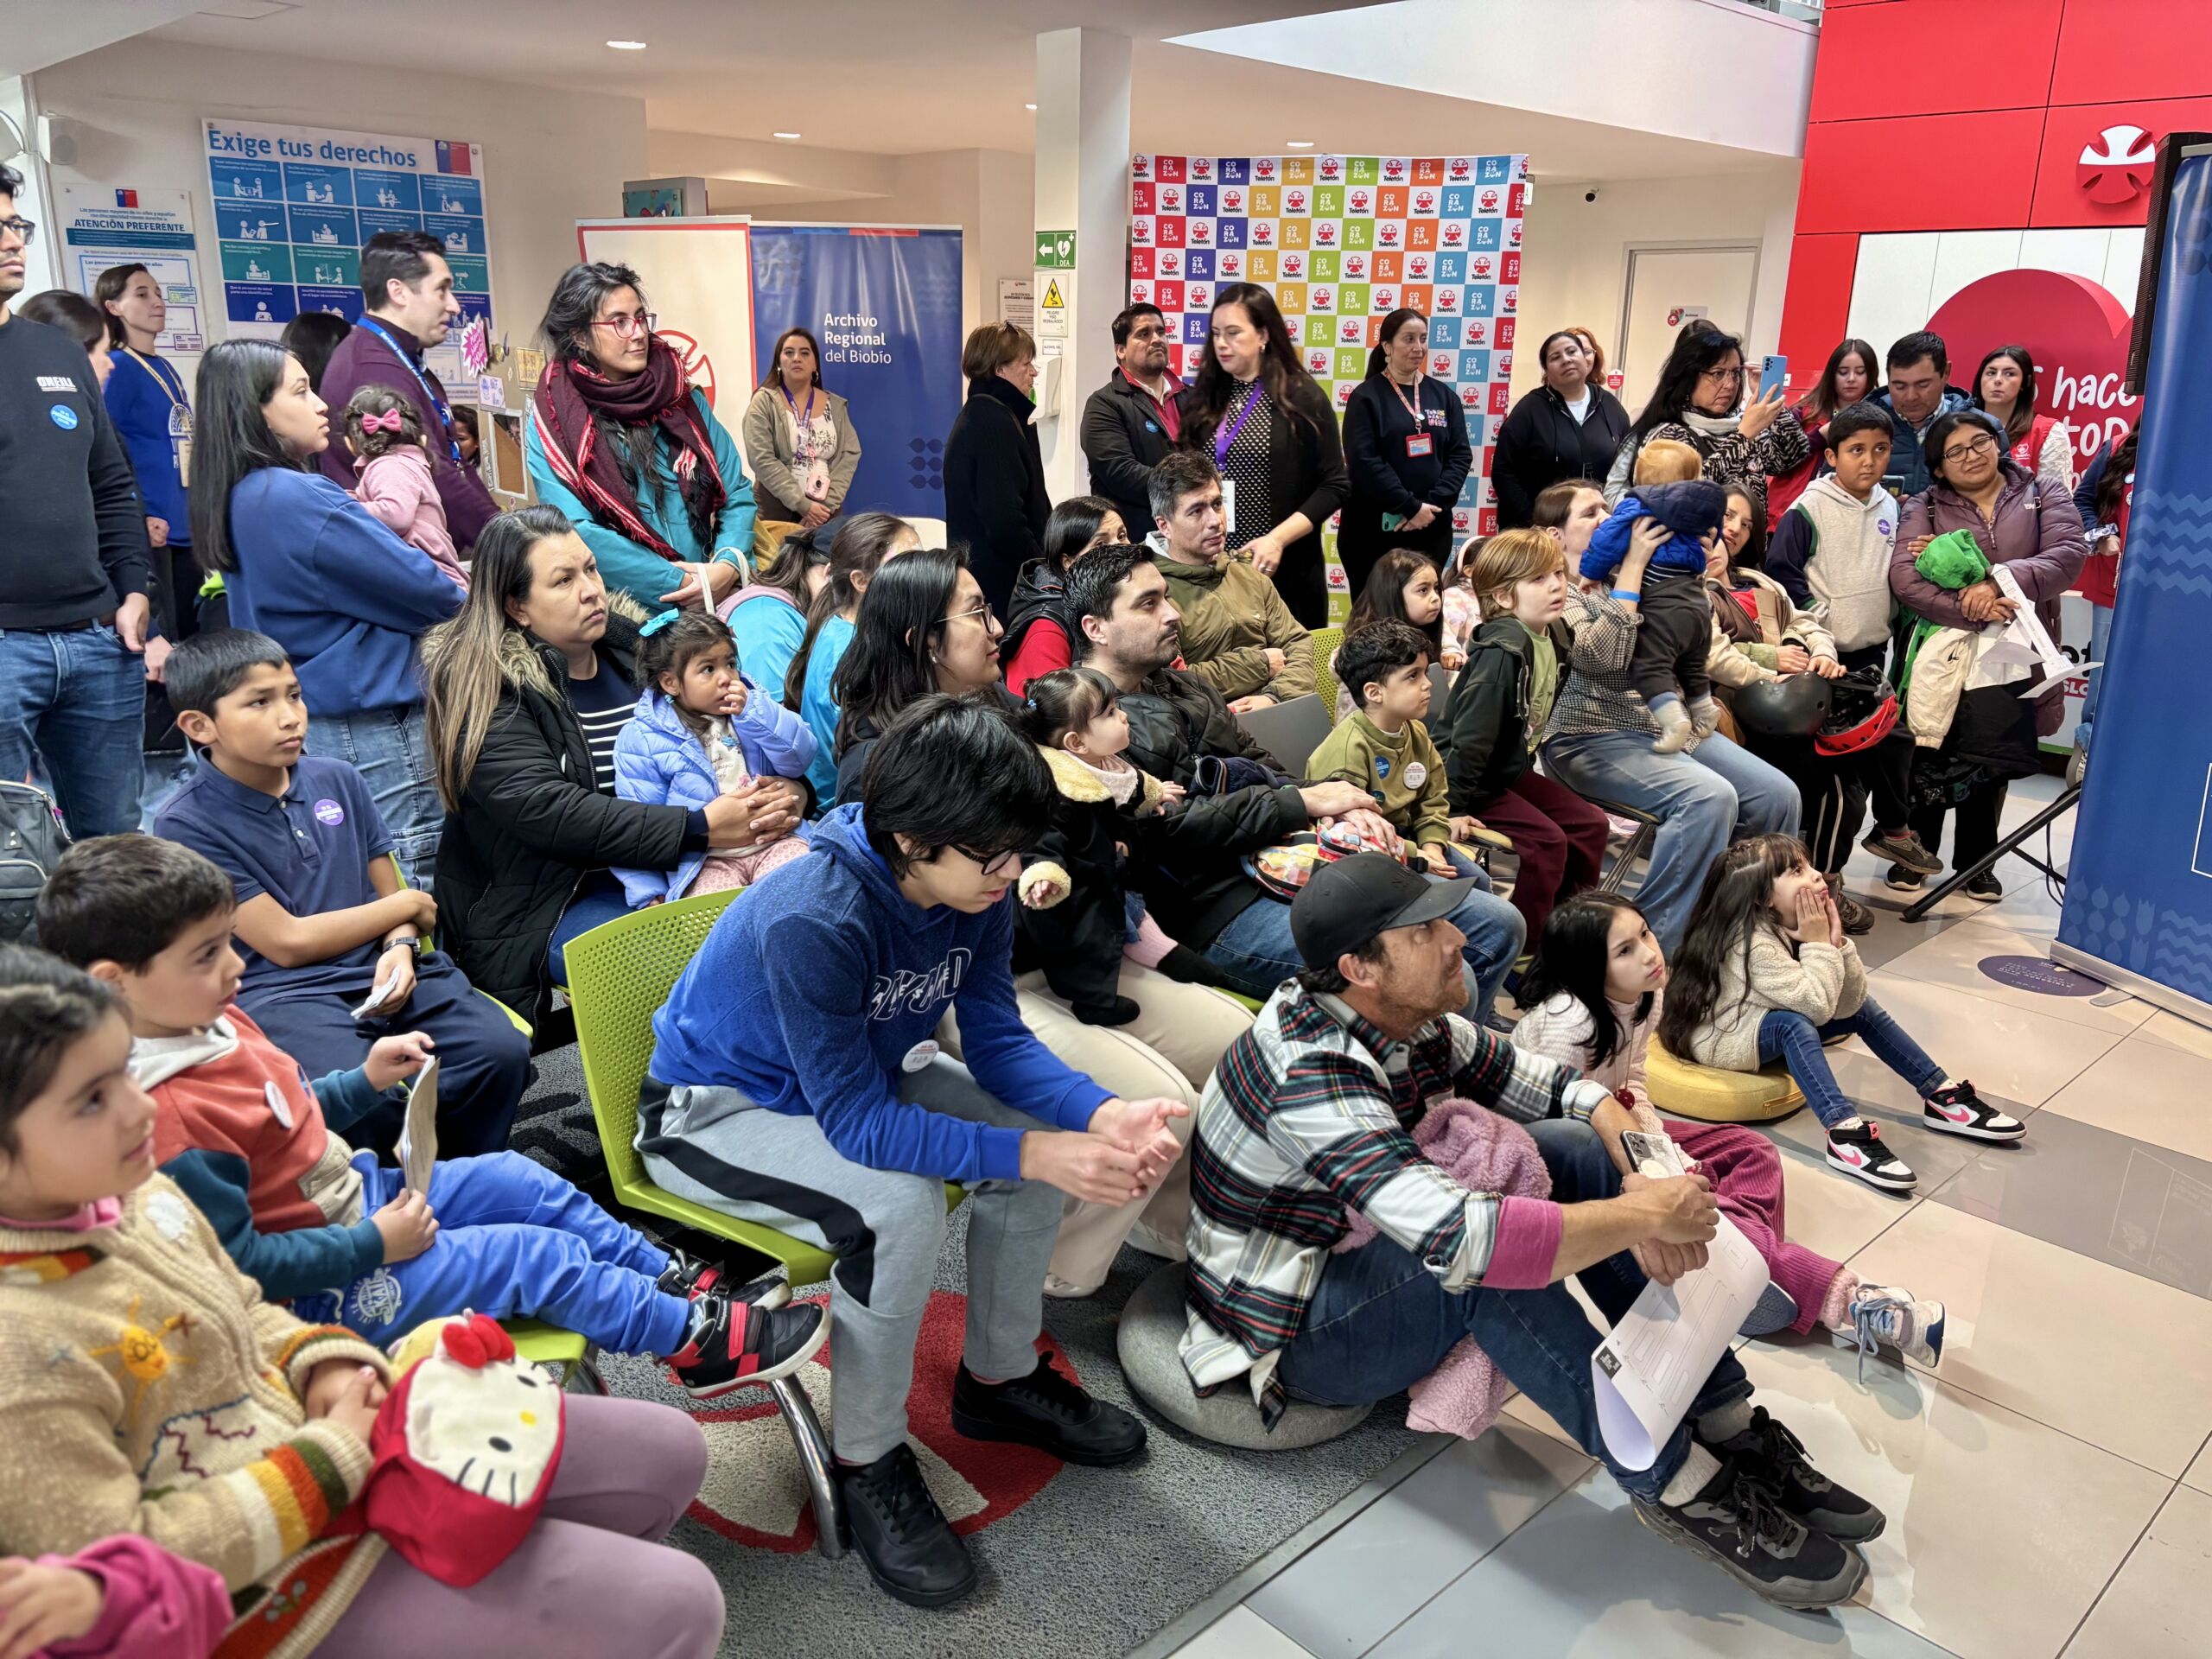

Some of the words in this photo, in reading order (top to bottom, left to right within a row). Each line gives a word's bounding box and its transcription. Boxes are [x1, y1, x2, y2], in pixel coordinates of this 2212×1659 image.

[208, 130, 271, 158] Exige
[277, 138, 313, 157] tus
[320, 140, 417, 167] derechos
[75, 219, 124, 229] ATENCIÓN
[127, 222, 185, 232] PREFERENTE
[824, 313, 878, 327] Archivo
[825, 331, 886, 348] Regional
[825, 349, 846, 362] del
[850, 350, 892, 364] Biobío
[2052, 366, 2137, 411] hace
